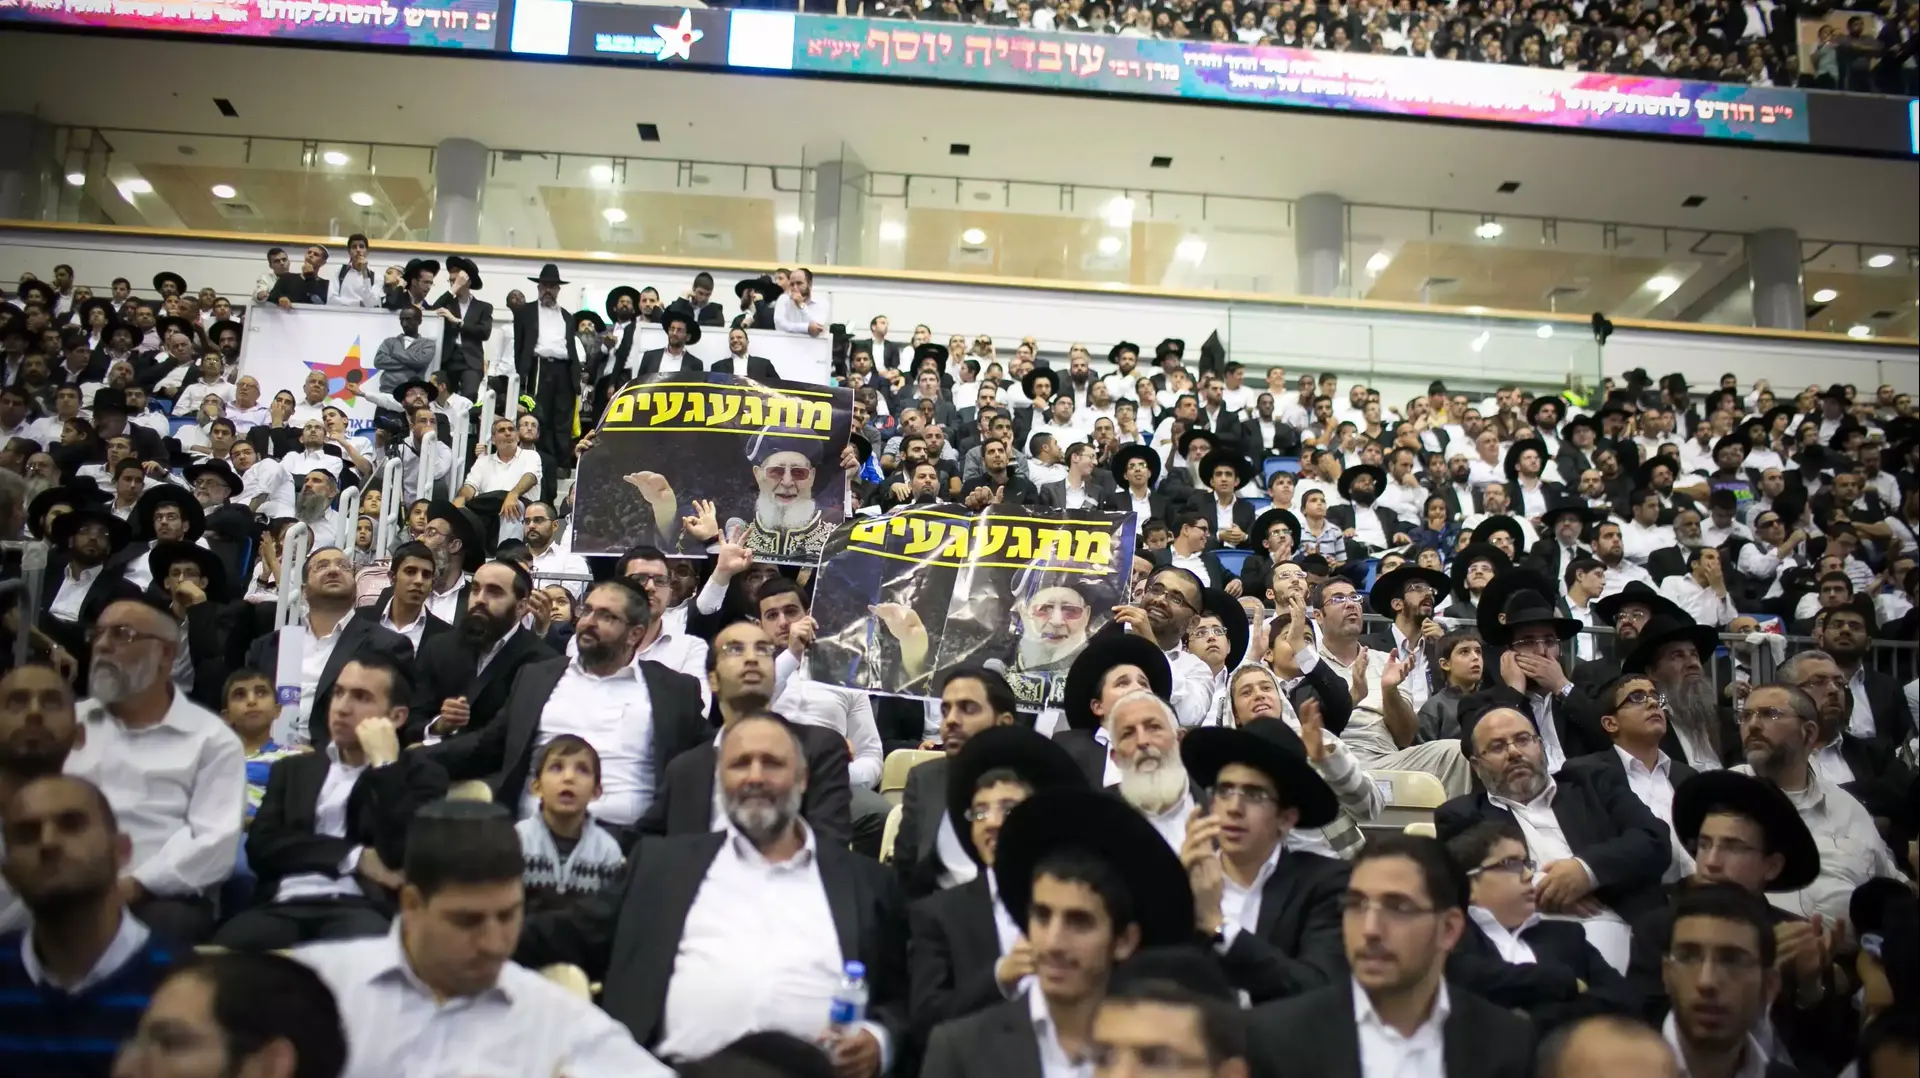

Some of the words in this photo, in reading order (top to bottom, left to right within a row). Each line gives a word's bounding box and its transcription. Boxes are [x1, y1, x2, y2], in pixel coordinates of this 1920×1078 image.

[403, 7, 468, 29] חודש
[866, 28, 952, 66] יוסף
[964, 35, 1105, 77] עובדיה
[1108, 60, 1140, 77] רבי
[1146, 60, 1180, 82] מרן
[1695, 98, 1755, 122] חודש
[605, 391, 833, 431] מתגעגעים
[849, 516, 1113, 565] מתגעגעים
